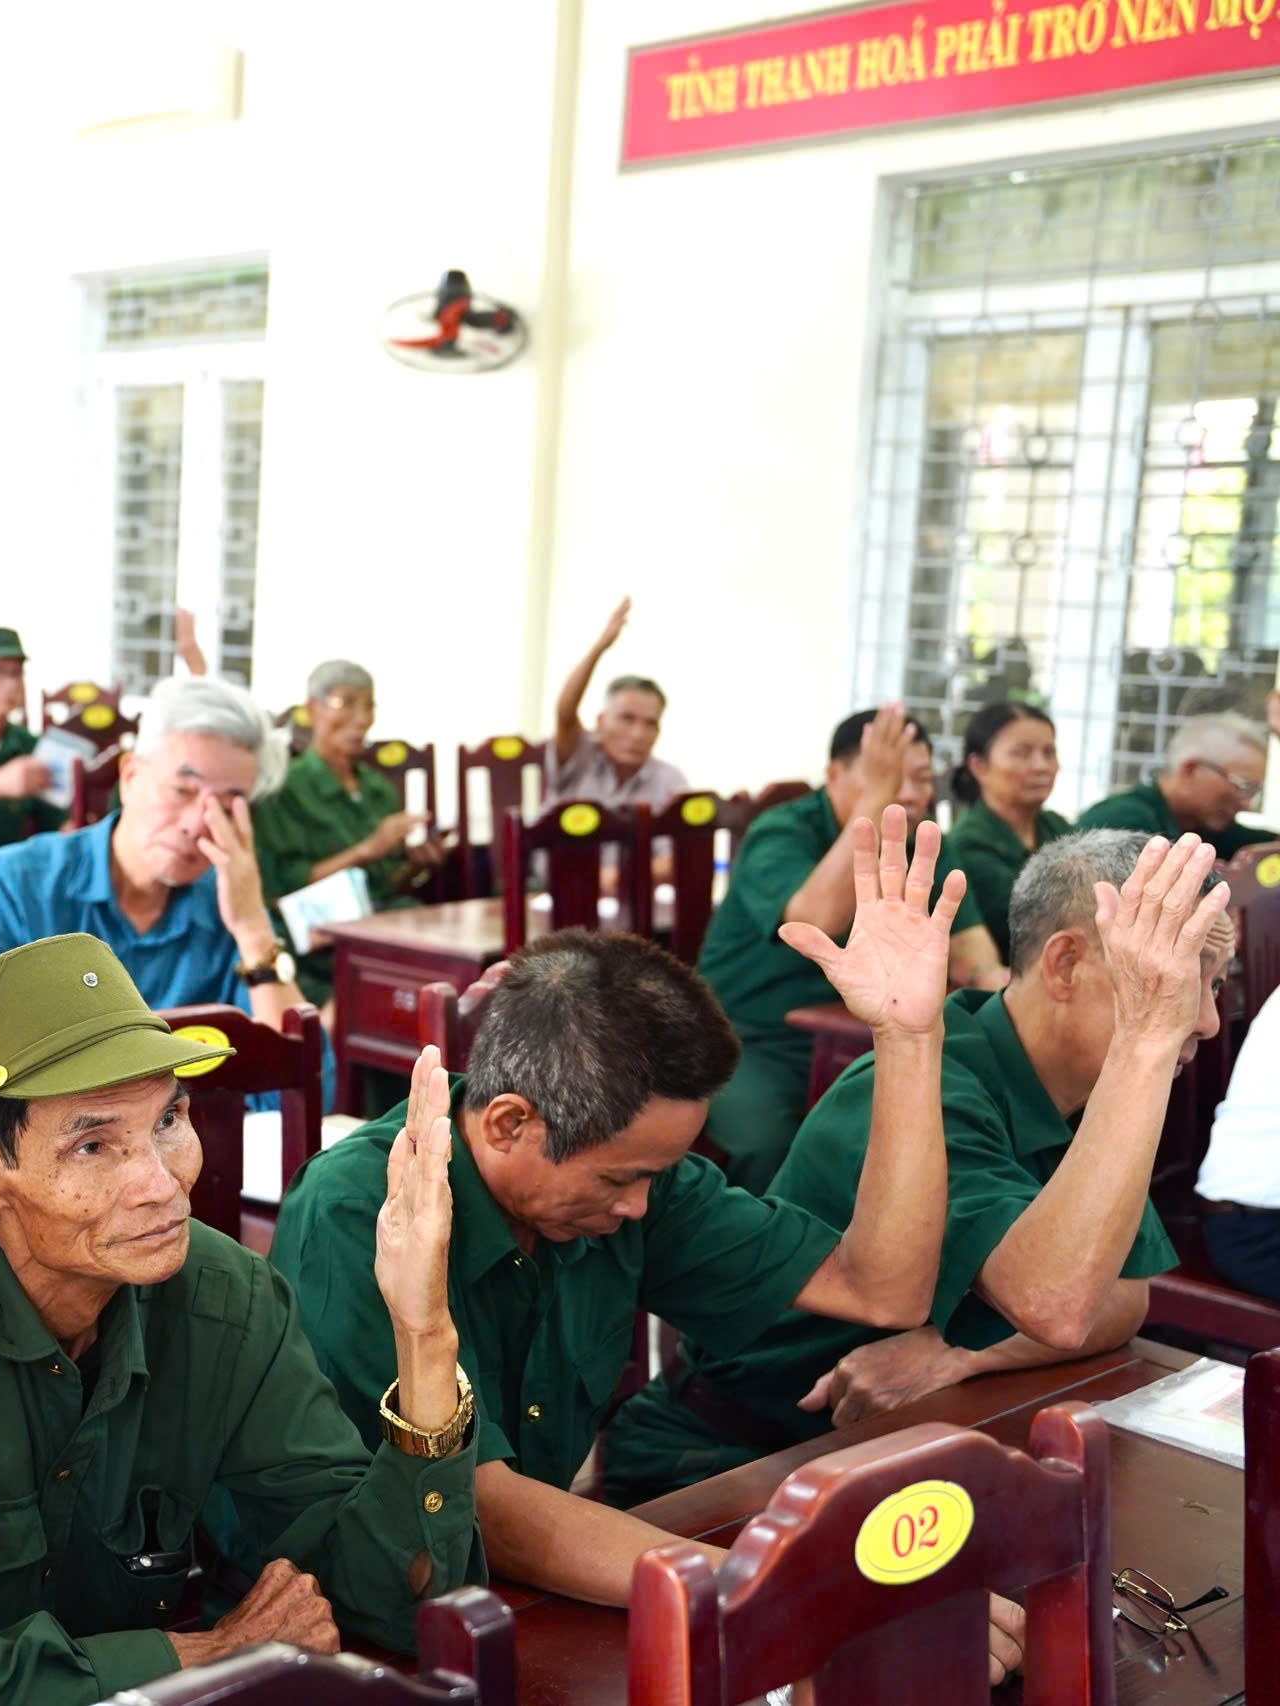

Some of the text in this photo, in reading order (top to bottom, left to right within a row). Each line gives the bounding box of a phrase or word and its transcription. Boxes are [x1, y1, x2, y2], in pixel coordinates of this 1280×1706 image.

[744, 44, 852, 108] THANH
[856, 15, 927, 90] HOÁ
[892, 1505, 939, 1558] 02
